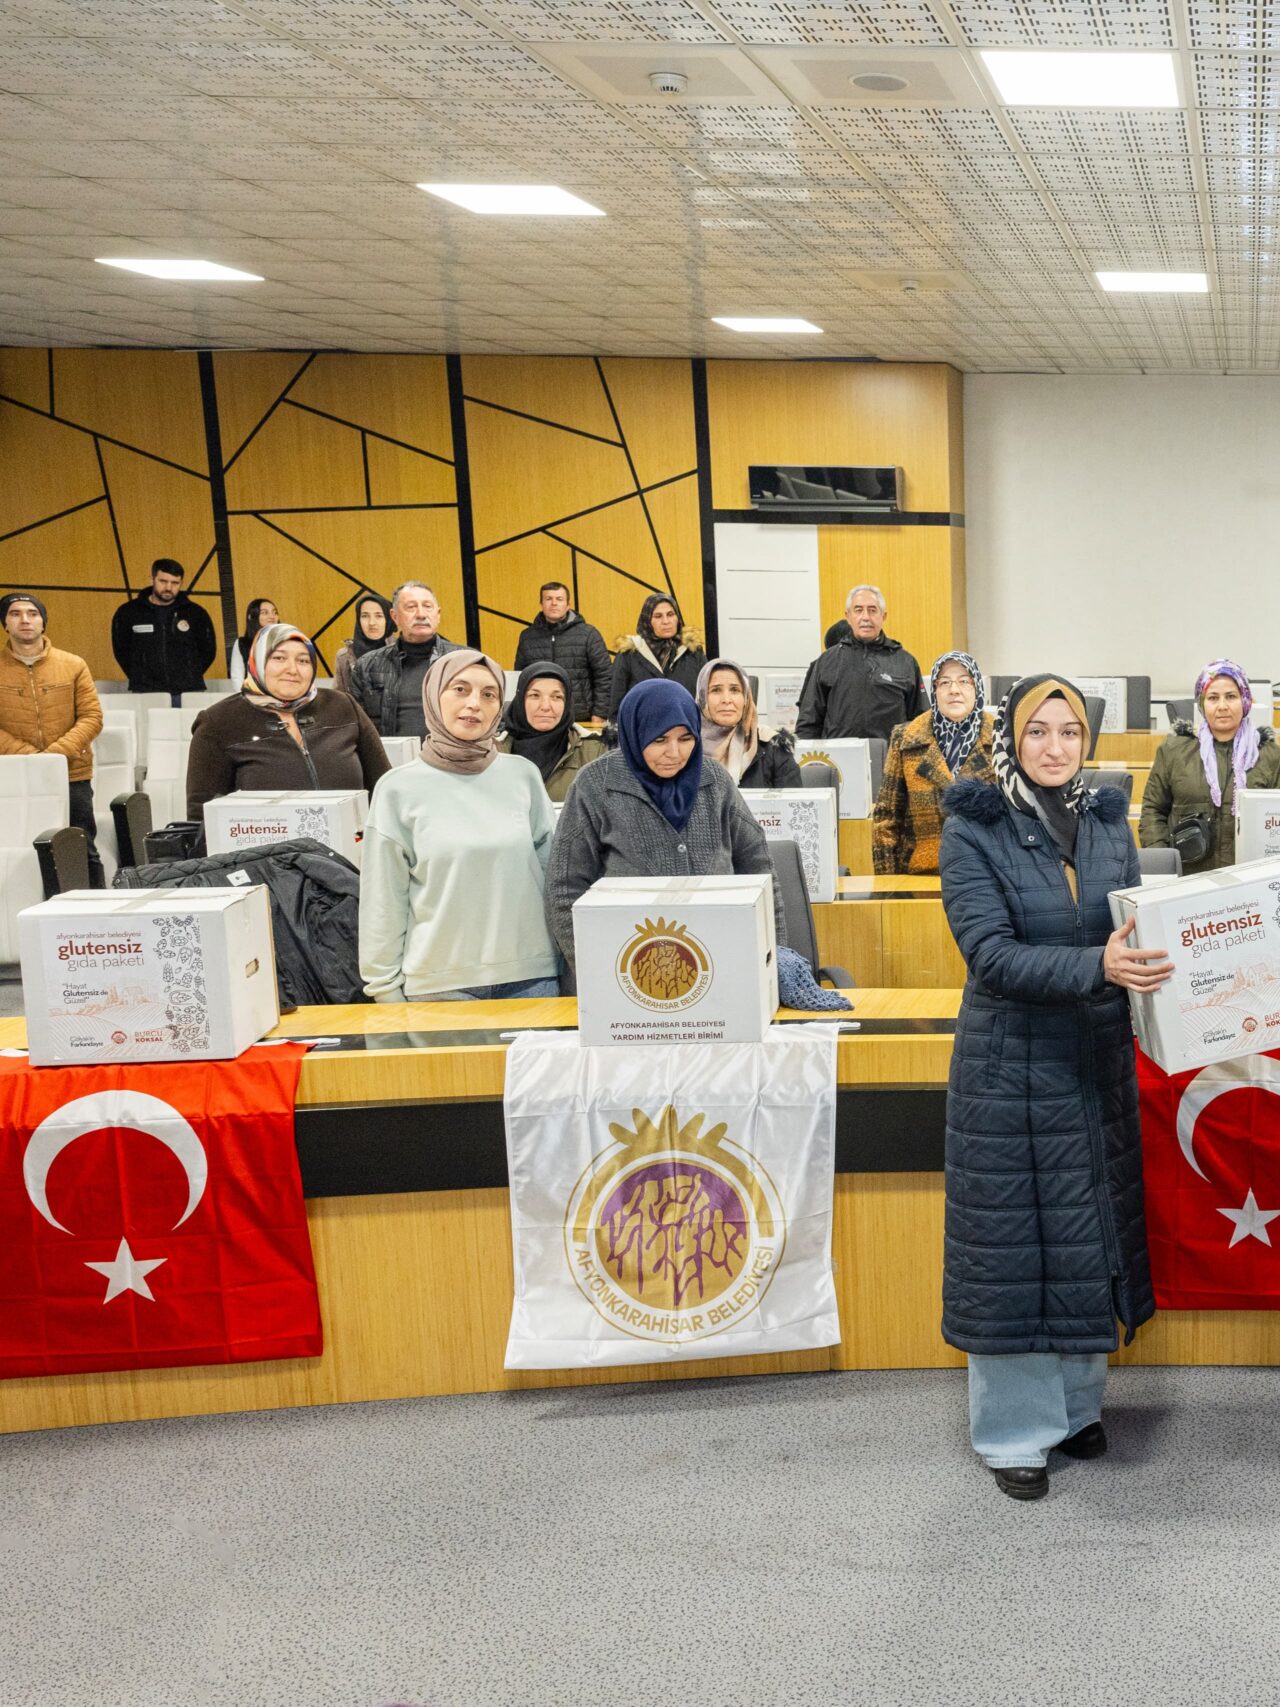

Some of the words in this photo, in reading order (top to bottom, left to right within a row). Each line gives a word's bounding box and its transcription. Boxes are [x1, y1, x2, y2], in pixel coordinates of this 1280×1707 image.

[230, 823, 288, 837] glutensiz
[1226, 900, 1259, 913] belediyesi
[1181, 910, 1263, 947] glutensiz
[58, 939, 143, 960] glutensiz
[1192, 937, 1221, 958] gıda
[1225, 925, 1266, 951] paketi
[68, 955, 97, 972] gıda
[102, 954, 144, 970] paketi
[1191, 973, 1226, 988] Glutensiz
[63, 989, 99, 997] Glutensiz
[621, 975, 679, 1009] AFYONKARAHİSAR
[610, 1021, 680, 1029] AFYONKARAHİSAR
[681, 1020, 726, 1028] BELEDİYESİ
[647, 1032, 695, 1040] HİZMETLERİ
[698, 1031, 723, 1039] BİRİMİ
[575, 1247, 705, 1334] AFYONKARAHİSAR
[707, 1245, 774, 1326] BELEDİYESİ
